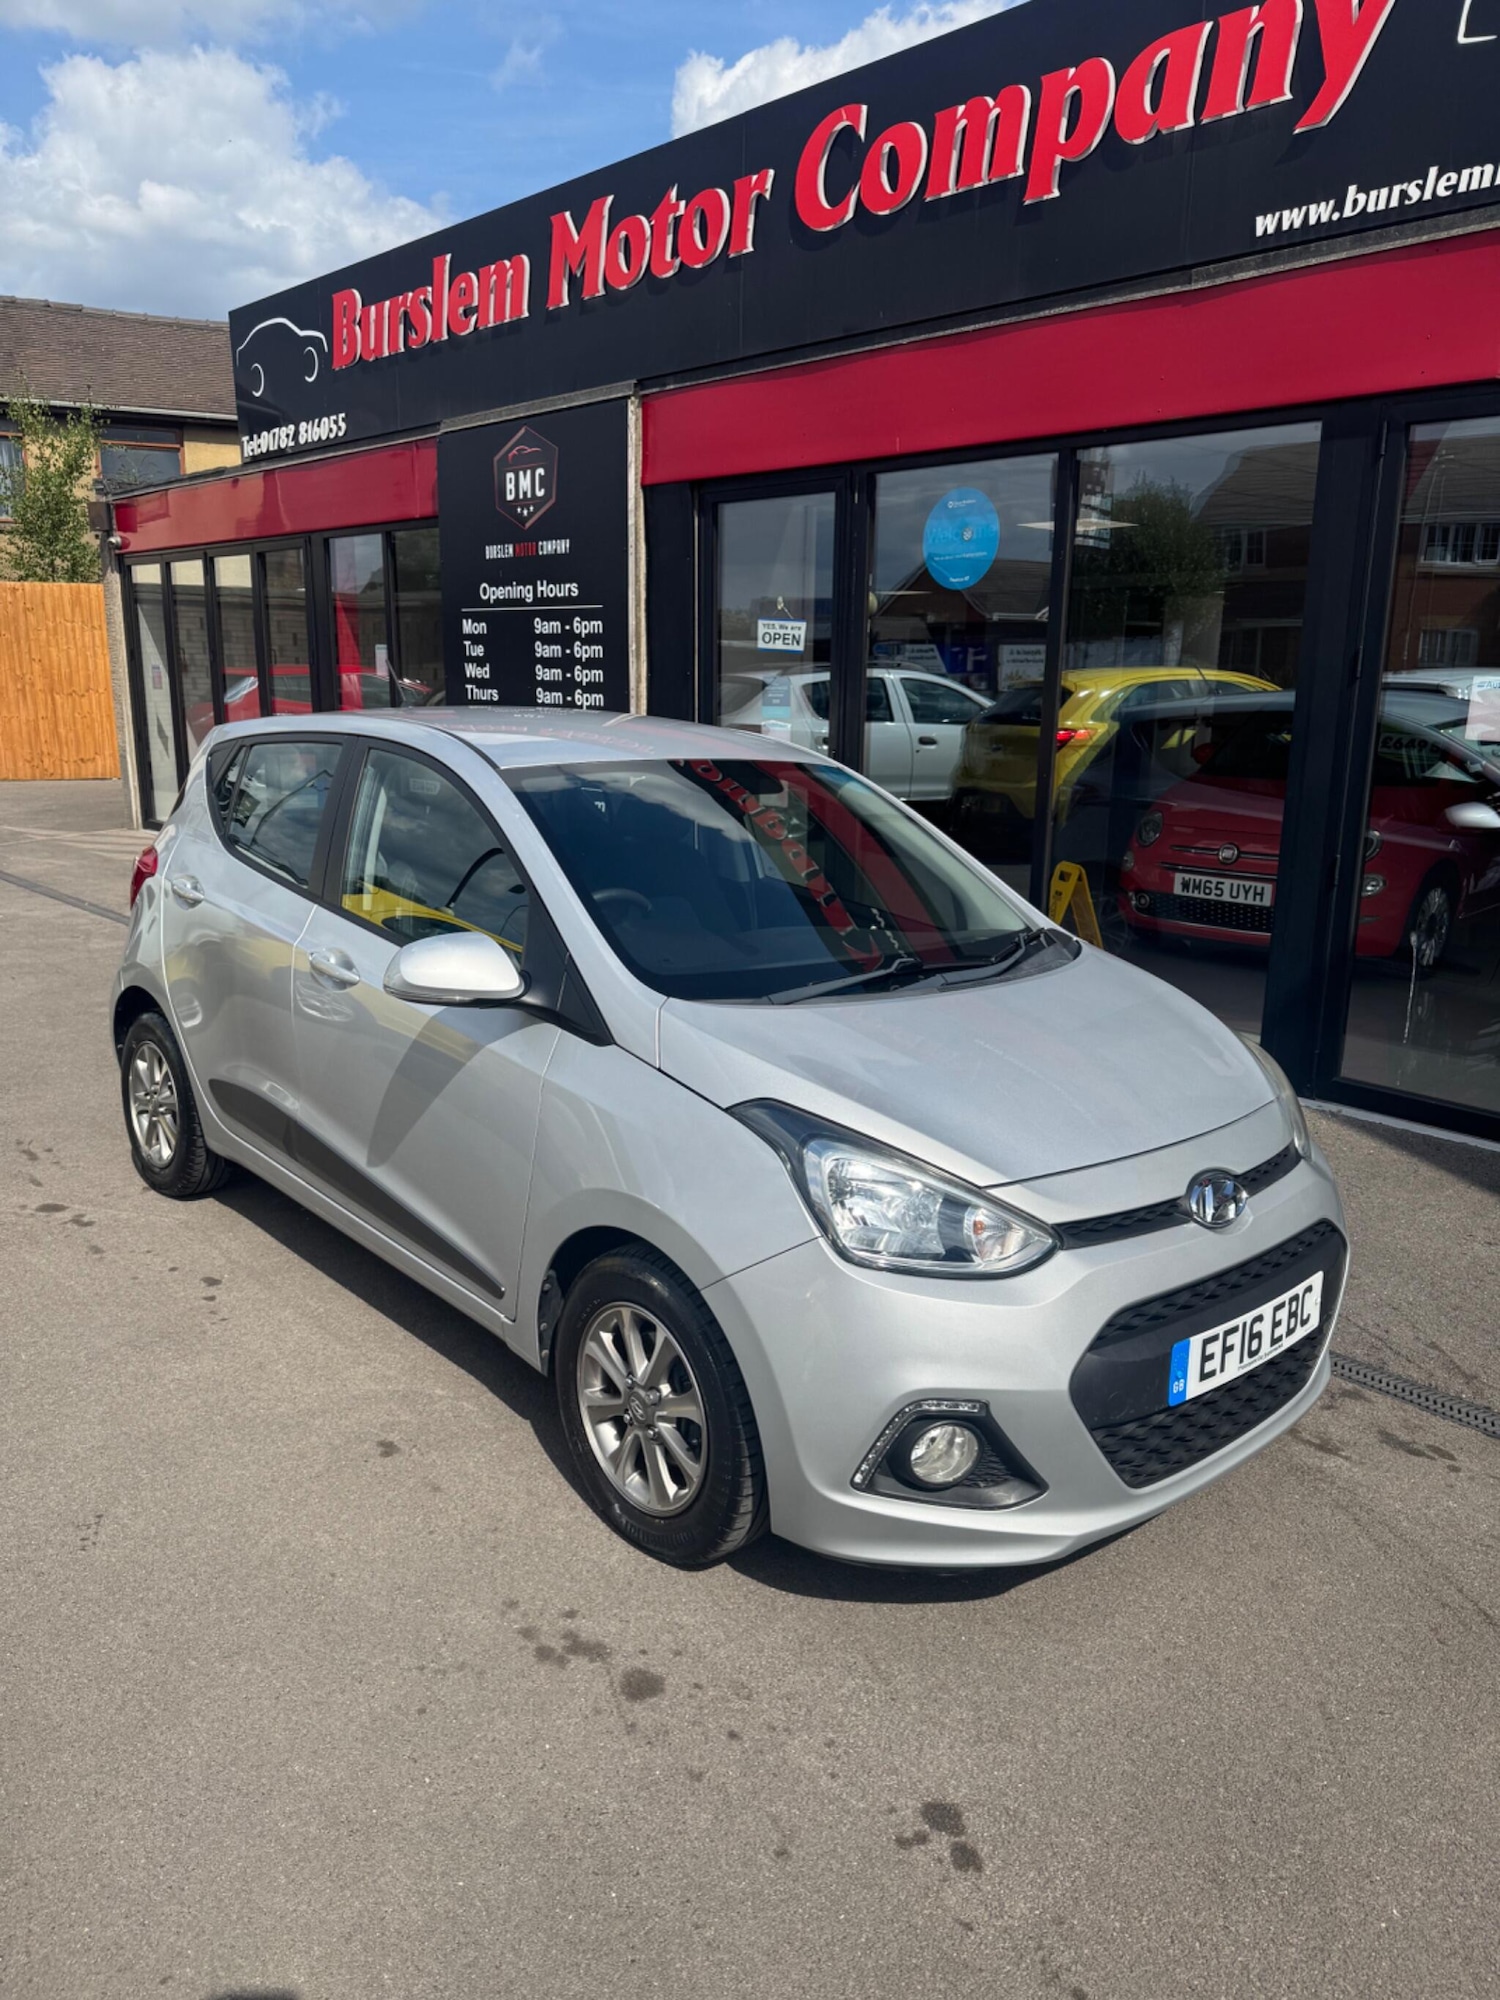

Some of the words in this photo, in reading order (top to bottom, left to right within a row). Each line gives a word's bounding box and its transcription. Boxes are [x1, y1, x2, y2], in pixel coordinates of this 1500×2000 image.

[332, 253, 530, 370] Burslem
[546, 168, 775, 310] Motor
[795, 0, 1398, 232] Company
[1255, 162, 1500, 237] www.burslem
[298, 412, 347, 445] 816055
[505, 467, 546, 501] BMC
[485, 543, 514, 560] BURSLEM
[538, 538, 570, 555] COMPANY
[479, 581, 533, 604] Opening
[537, 579, 579, 598] Hours
[462, 618, 487, 634] Mon
[533, 617, 561, 634] 9am
[573, 616, 603, 638] 6pm
[762, 631, 801, 646] OPEN
[463, 641, 485, 656] Tue
[534, 641, 562, 658] 9am
[573, 640, 603, 662] 6pm
[464, 662, 490, 679] Wed
[535, 664, 562, 681] 9am
[574, 665, 604, 686] 6pm
[465, 684, 499, 701] Thurs
[535, 687, 563, 704] 9am
[574, 688, 604, 709] 6pm
[1181, 876, 1225, 898] WM65
[1229, 882, 1265, 903] UYH
[1199, 1313, 1264, 1382] EF16
[1270, 1284, 1313, 1348] EBC
[1173, 1378, 1185, 1394] GB
